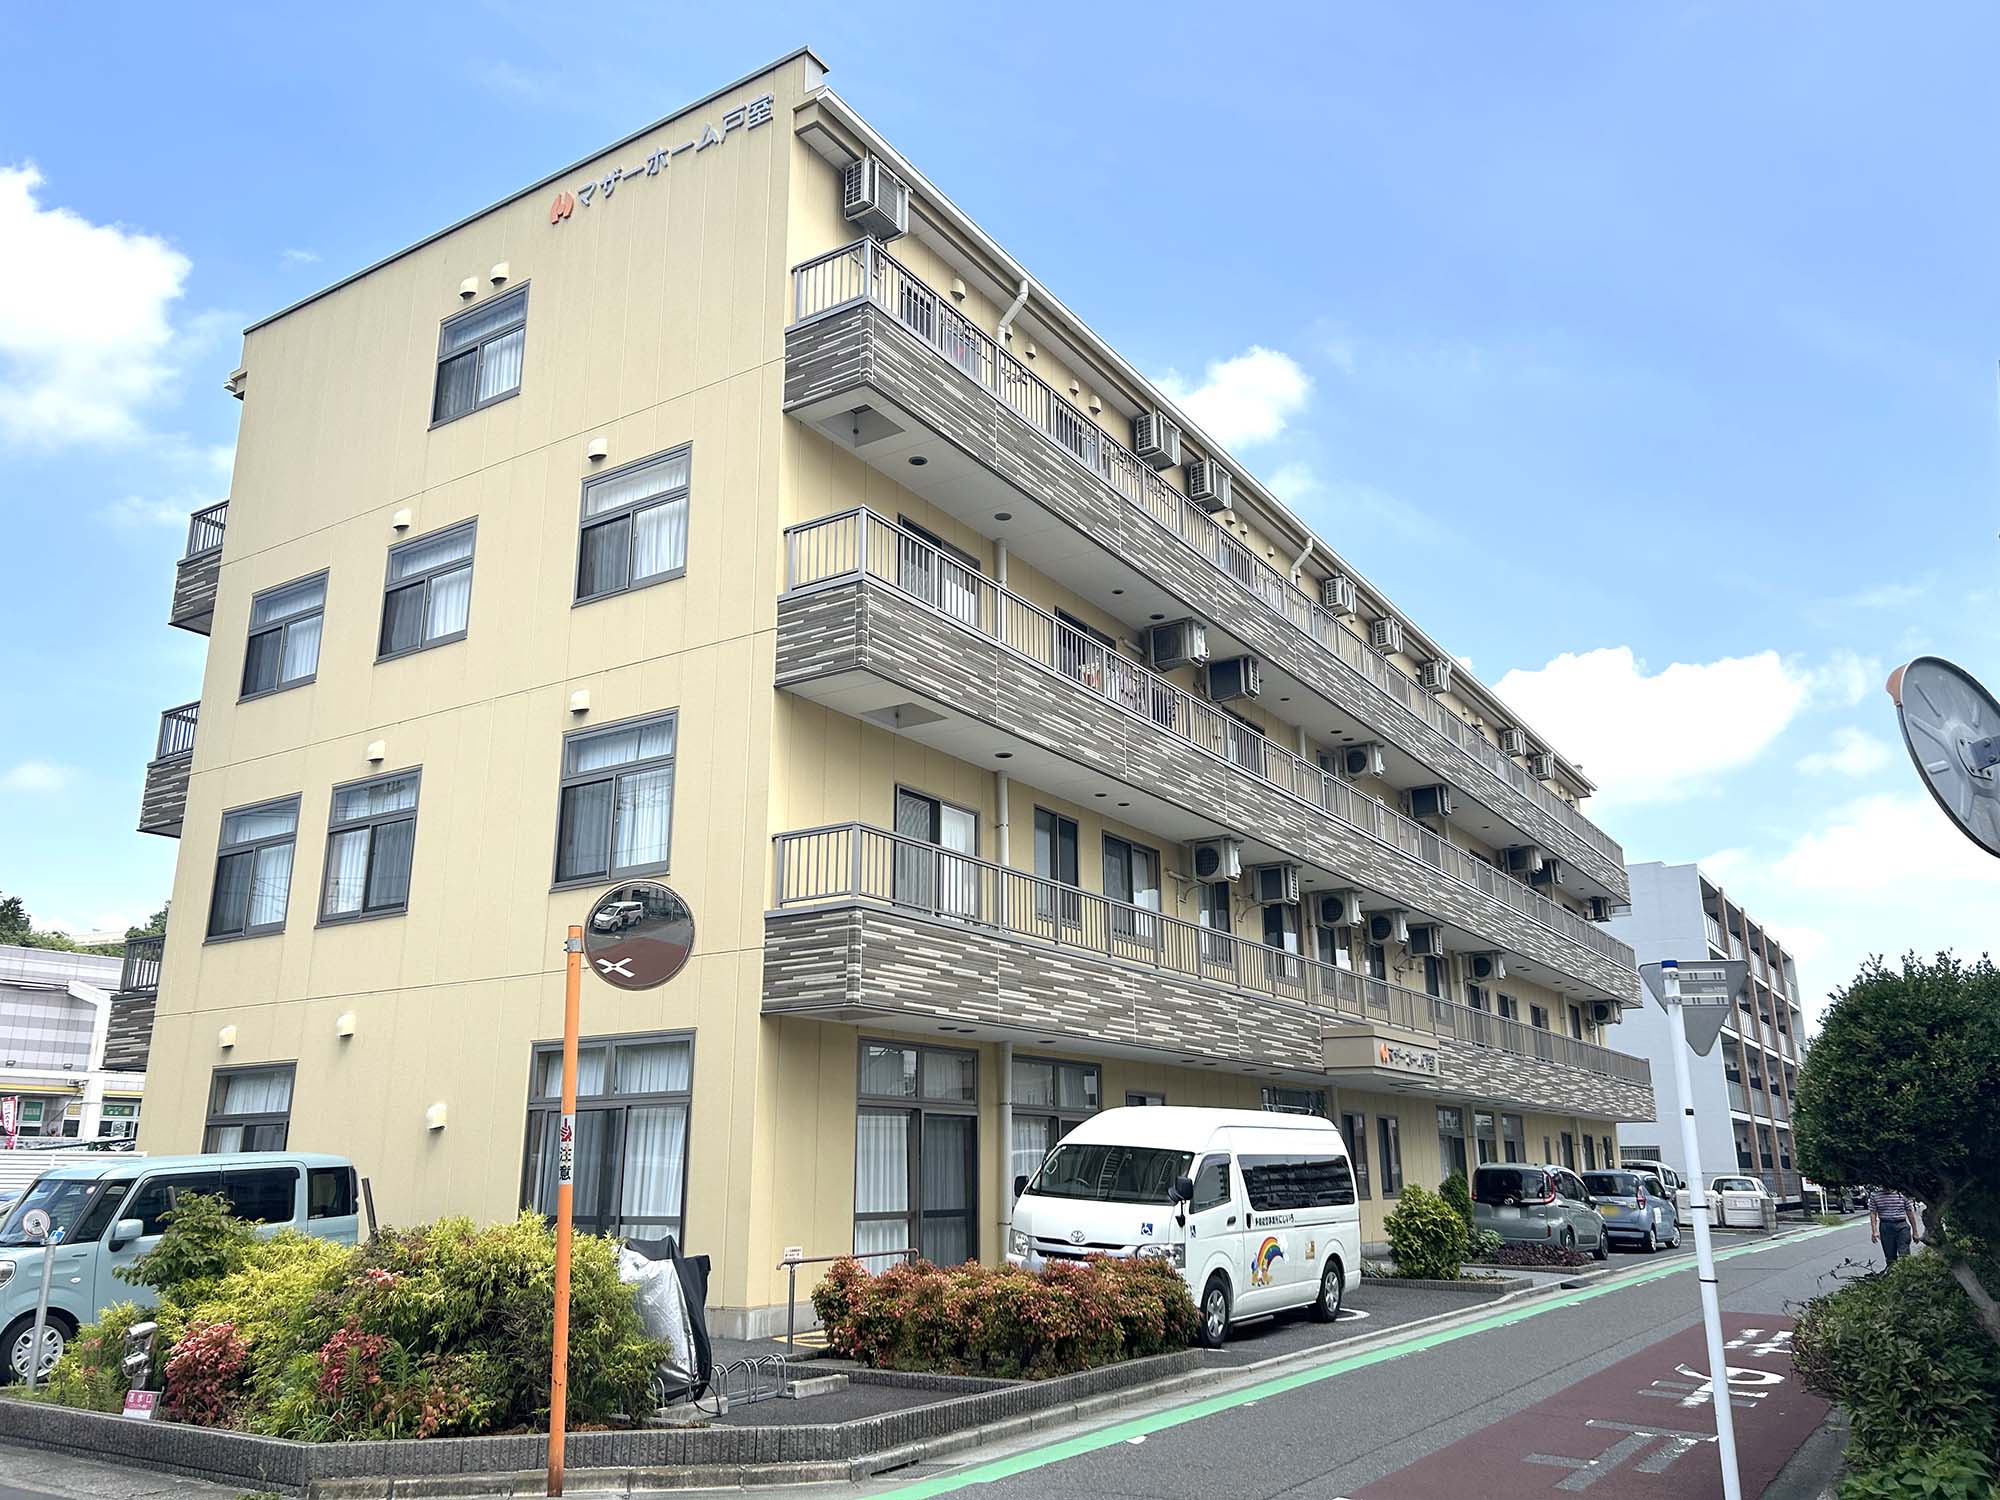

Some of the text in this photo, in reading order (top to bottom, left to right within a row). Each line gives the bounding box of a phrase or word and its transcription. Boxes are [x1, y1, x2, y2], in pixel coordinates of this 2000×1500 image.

[577, 92, 774, 206] マザーホーム戸室
[559, 1145, 572, 1181] 注意
